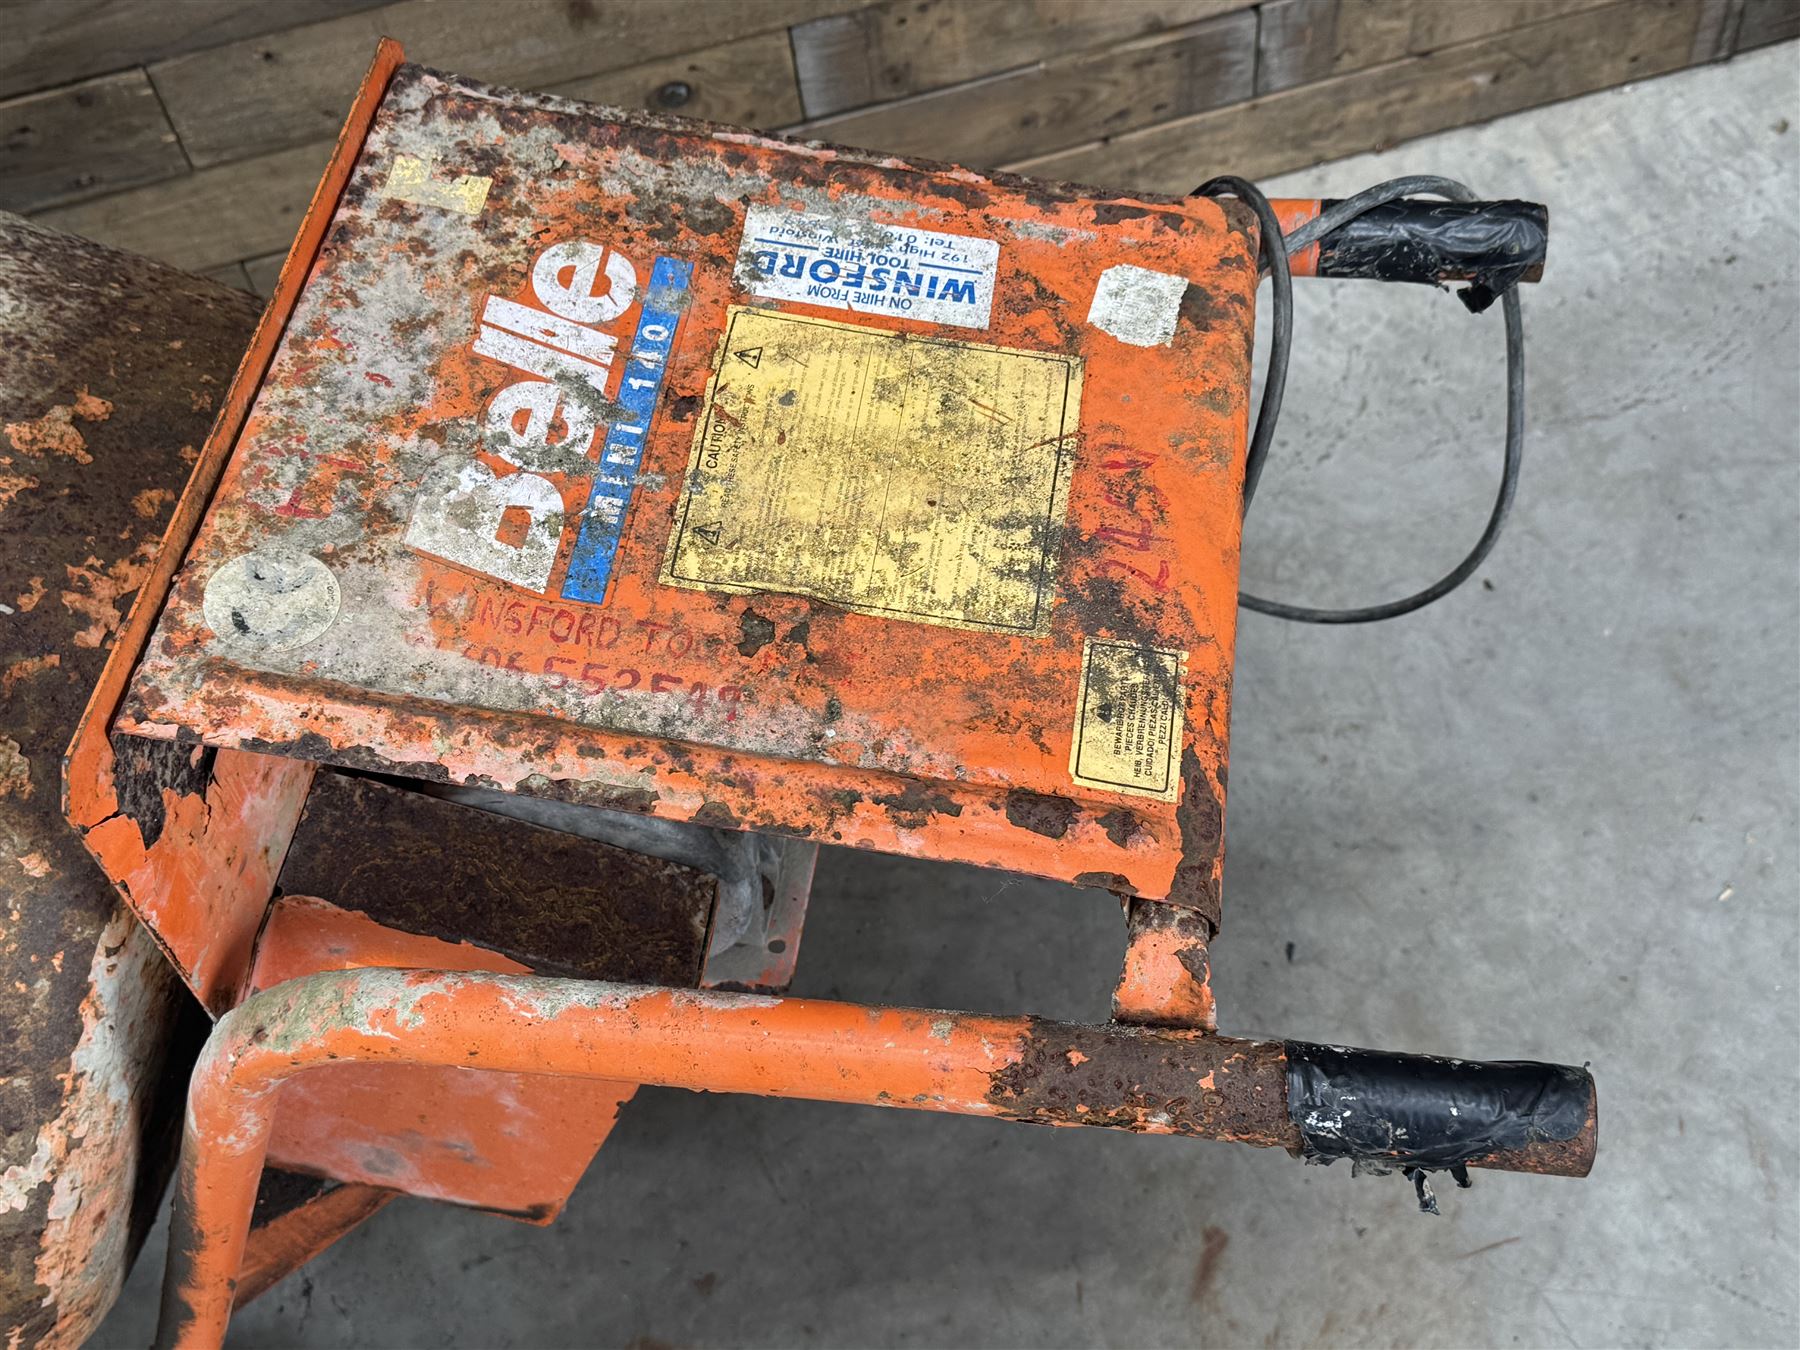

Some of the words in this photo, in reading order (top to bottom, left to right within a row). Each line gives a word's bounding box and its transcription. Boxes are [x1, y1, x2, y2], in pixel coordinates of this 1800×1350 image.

[924, 236, 954, 249] Tel:
[823, 246, 861, 262] HIRE
[865, 252, 910, 269] TOOL
[941, 251, 968, 262] 192
[748, 249, 977, 304] WINSFORD
[806, 284, 848, 300] FROM
[852, 291, 885, 306] HIRE
[888, 295, 912, 310] ON
[404, 241, 637, 592] Belle
[589, 420, 644, 525] MINI
[626, 321, 670, 391] 140
[705, 415, 727, 469] CAUTION
